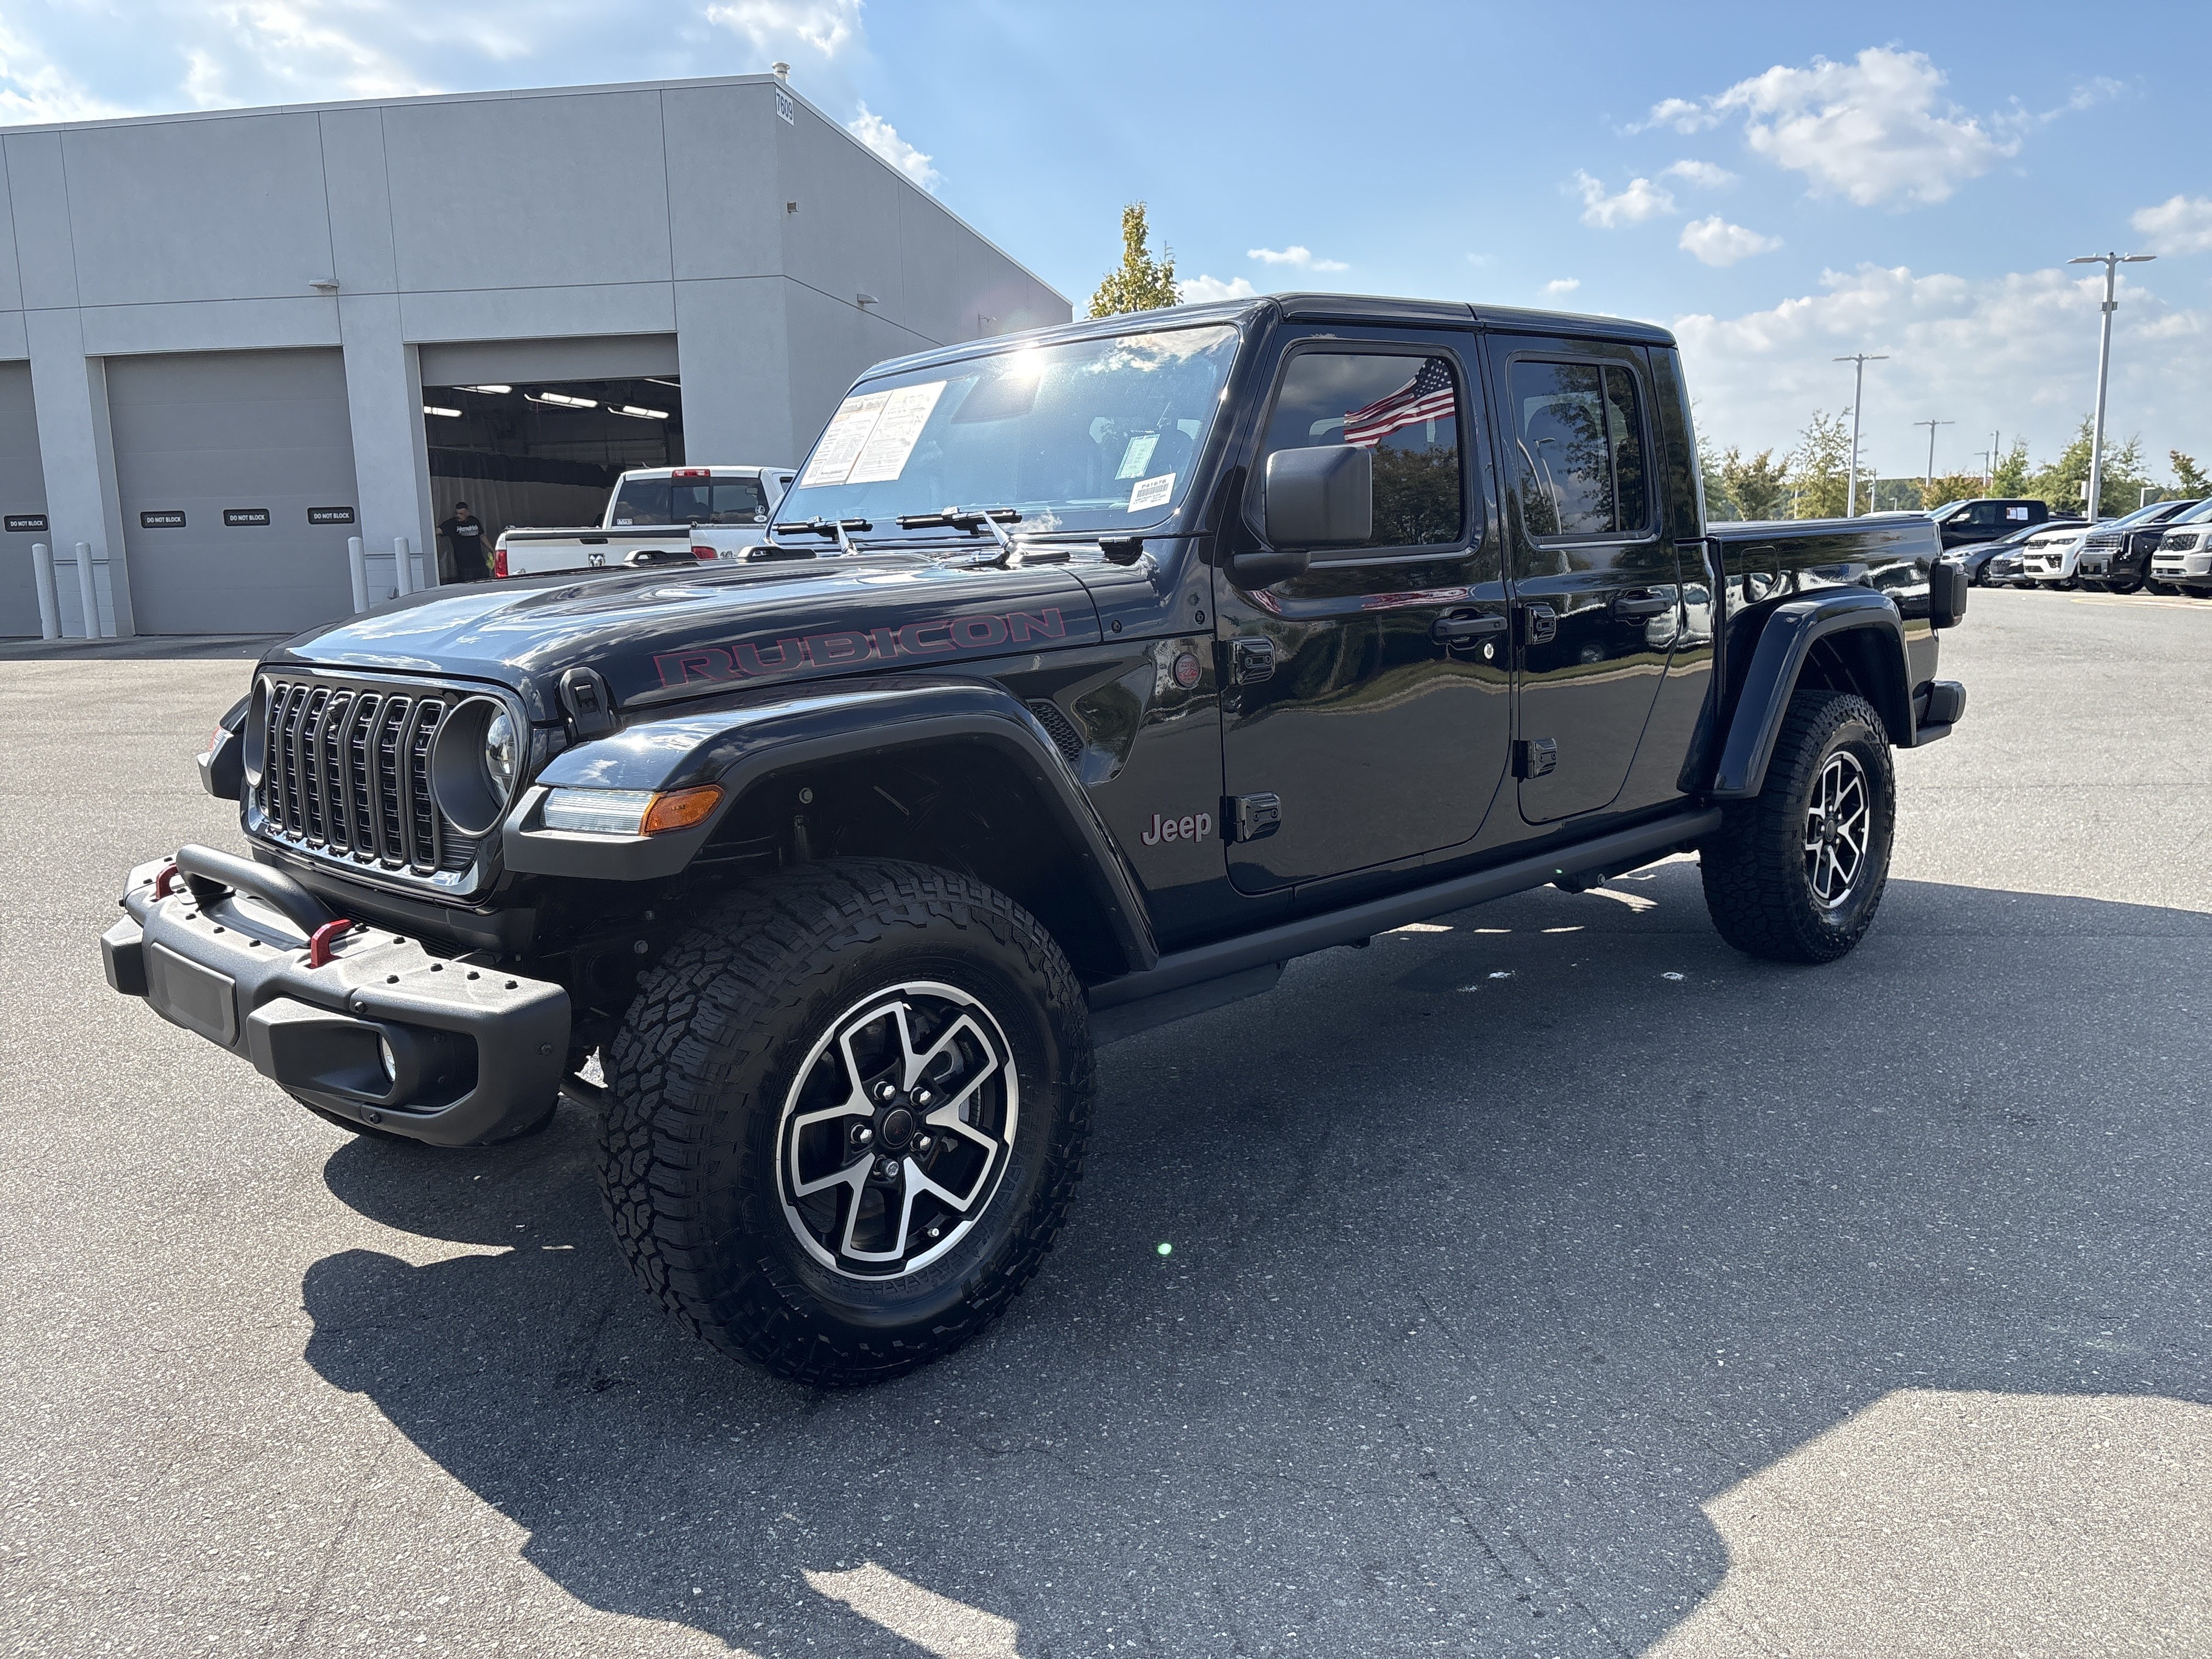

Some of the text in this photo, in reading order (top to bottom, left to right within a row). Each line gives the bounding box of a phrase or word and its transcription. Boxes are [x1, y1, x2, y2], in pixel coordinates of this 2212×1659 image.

[776, 92, 793, 120] 7609
[652, 608, 1066, 689] RUBICON
[1141, 813, 1212, 846] Jeep
